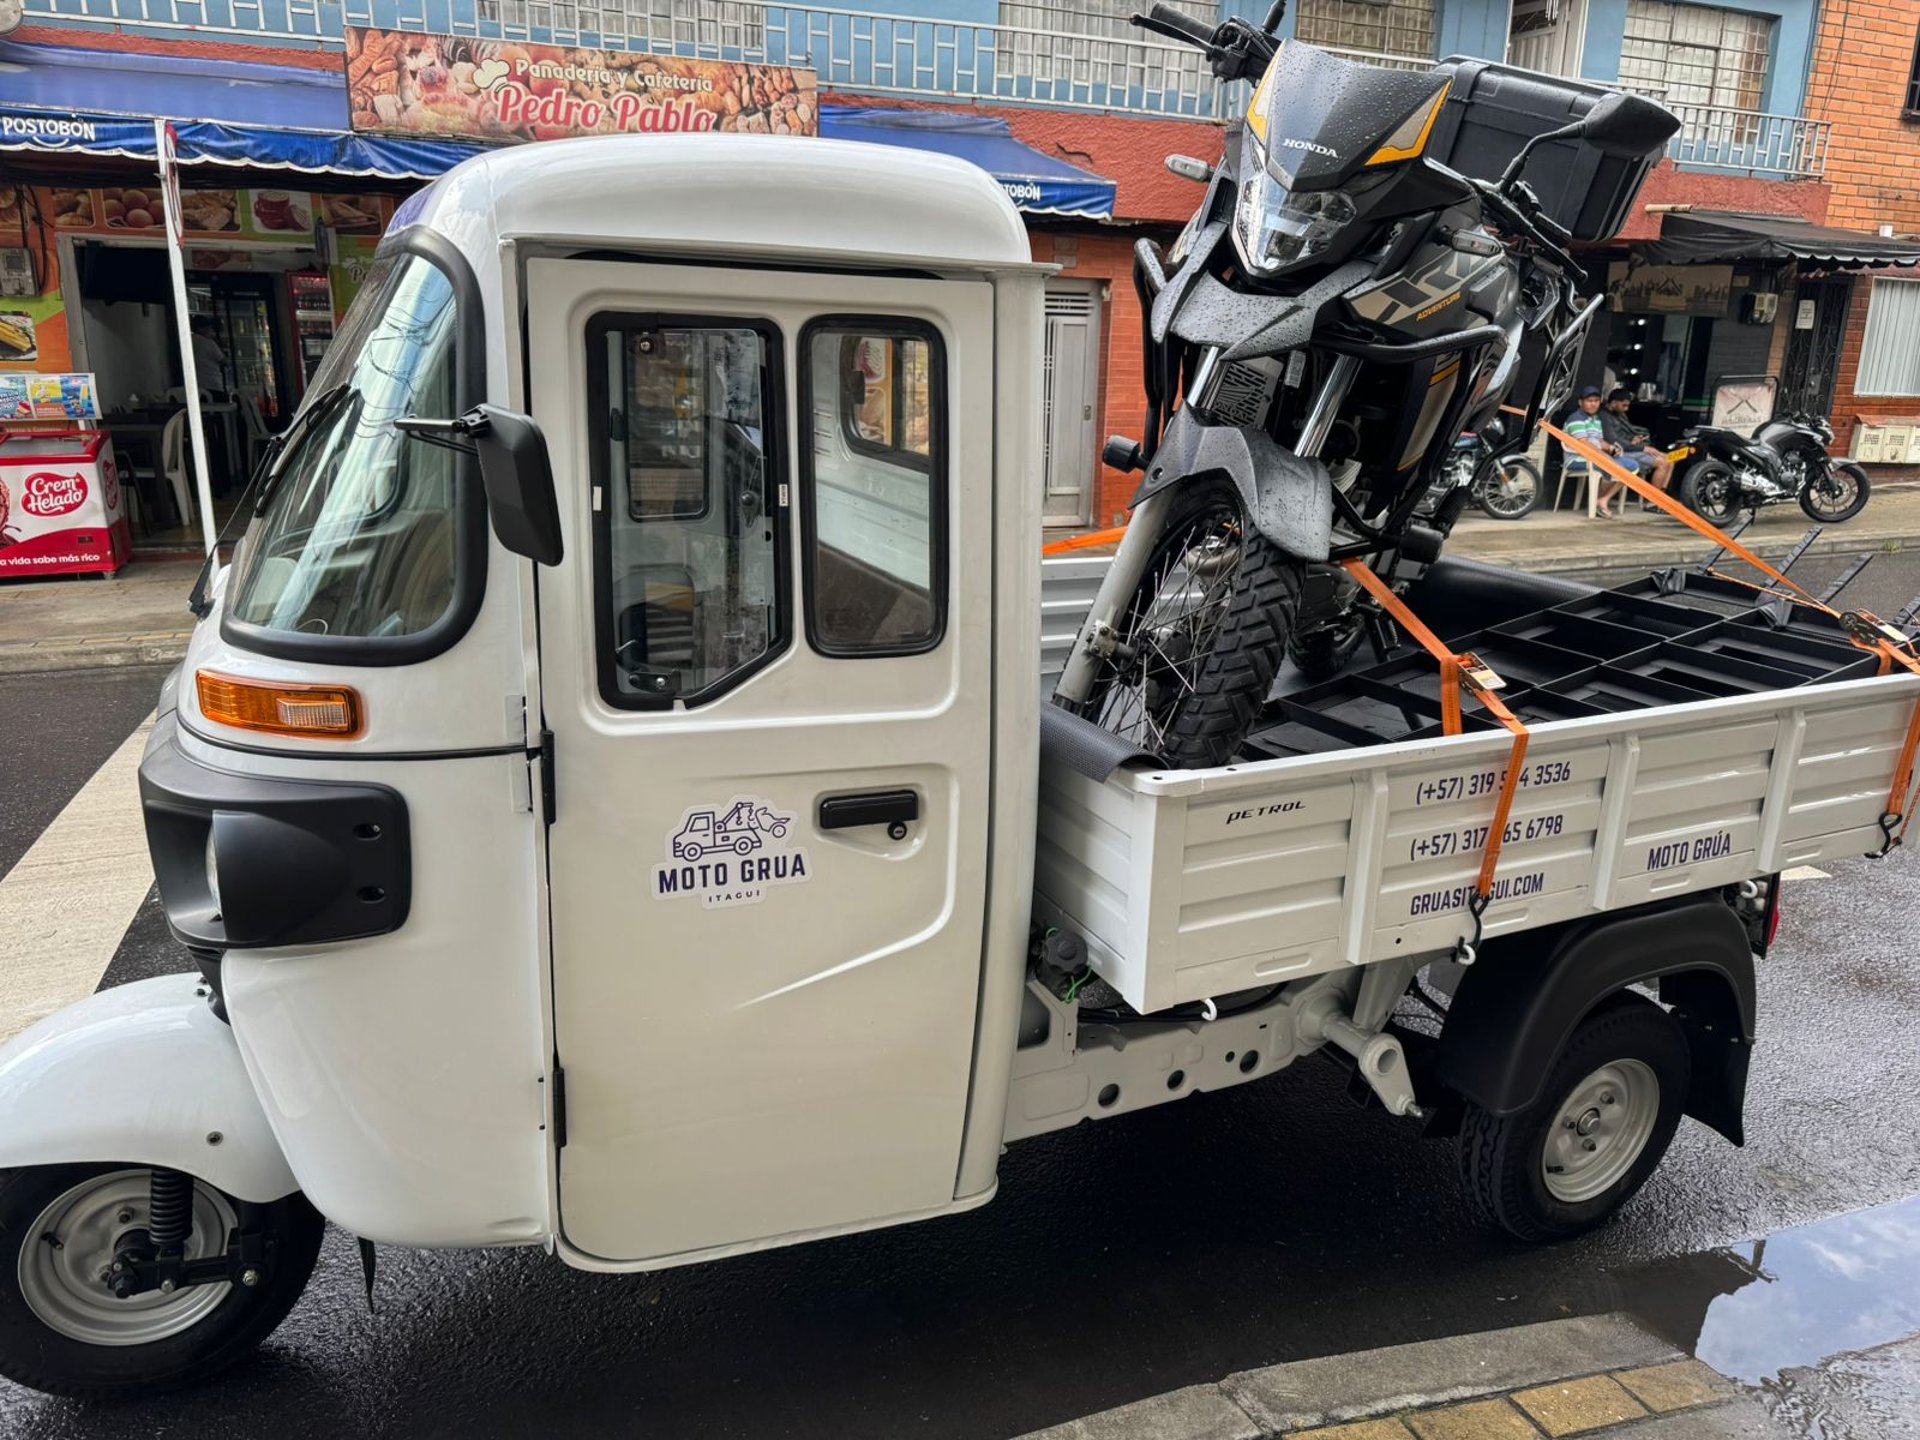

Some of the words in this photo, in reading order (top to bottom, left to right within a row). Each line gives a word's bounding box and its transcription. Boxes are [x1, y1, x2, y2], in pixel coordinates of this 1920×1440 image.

[618, 72, 628, 88] y
[495, 83, 603, 129] Pedro
[613, 92, 717, 132] Pablo
[1282, 138, 1339, 159] HONDA
[1416, 291, 1462, 321] ADVENTURE
[31, 477, 77, 496] Crem
[27, 489, 84, 513] Helado
[9, 555, 31, 566] vida
[33, 555, 57, 565] sabe
[59, 553, 80, 563] más
[81, 552, 101, 562] rico
[1416, 776, 1464, 805] (+57)
[1468, 772, 1495, 796] 319
[1534, 761, 1571, 786] 3536
[1226, 801, 1306, 825] PETROL
[1410, 832, 1457, 861] (+57)
[1462, 827, 1489, 851] 317
[1493, 821, 1522, 845] 65
[1526, 815, 1563, 840] 6798
[1647, 841, 1689, 871] MOTO
[1692, 830, 1731, 861] GRÚA
[659, 863, 728, 894] MOTO
[741, 854, 806, 883] GRUA
[708, 889, 760, 903] ITAGUI
